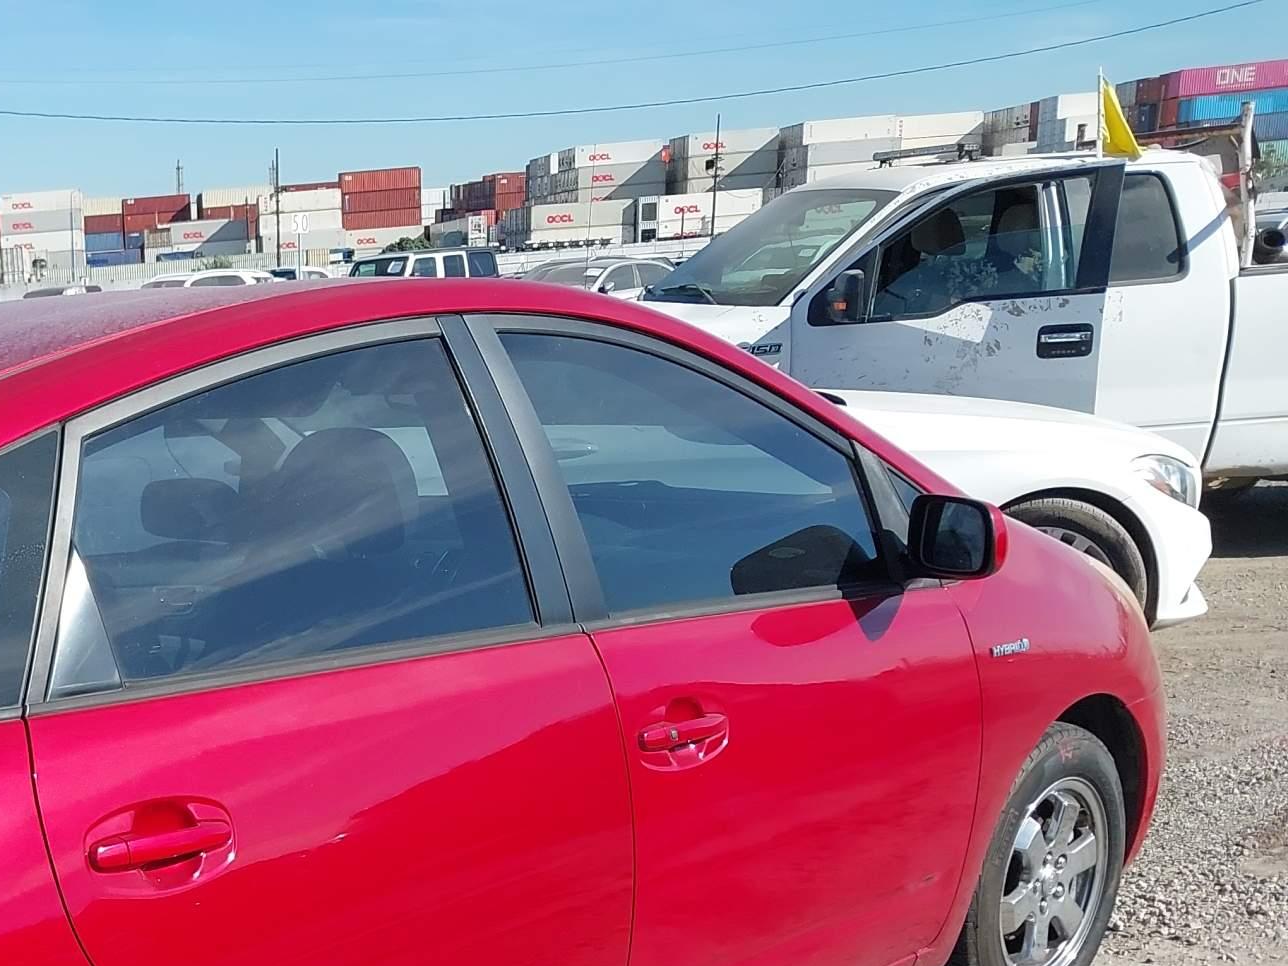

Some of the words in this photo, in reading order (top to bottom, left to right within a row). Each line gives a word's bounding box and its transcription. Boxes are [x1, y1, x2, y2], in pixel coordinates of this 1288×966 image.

[1215, 66, 1256, 85] ONE
[702, 141, 726, 151] OOCL
[588, 152, 612, 162] OOCL
[591, 173, 615, 183] OOCL
[11, 202, 33, 210] OOCL
[674, 204, 701, 215] OOCL
[547, 214, 574, 224] OOCL
[12, 222, 34, 231] OOCL
[183, 230, 205, 240] OOCL
[279, 241, 298, 250] OCL
[356, 237, 377, 246] OOCL
